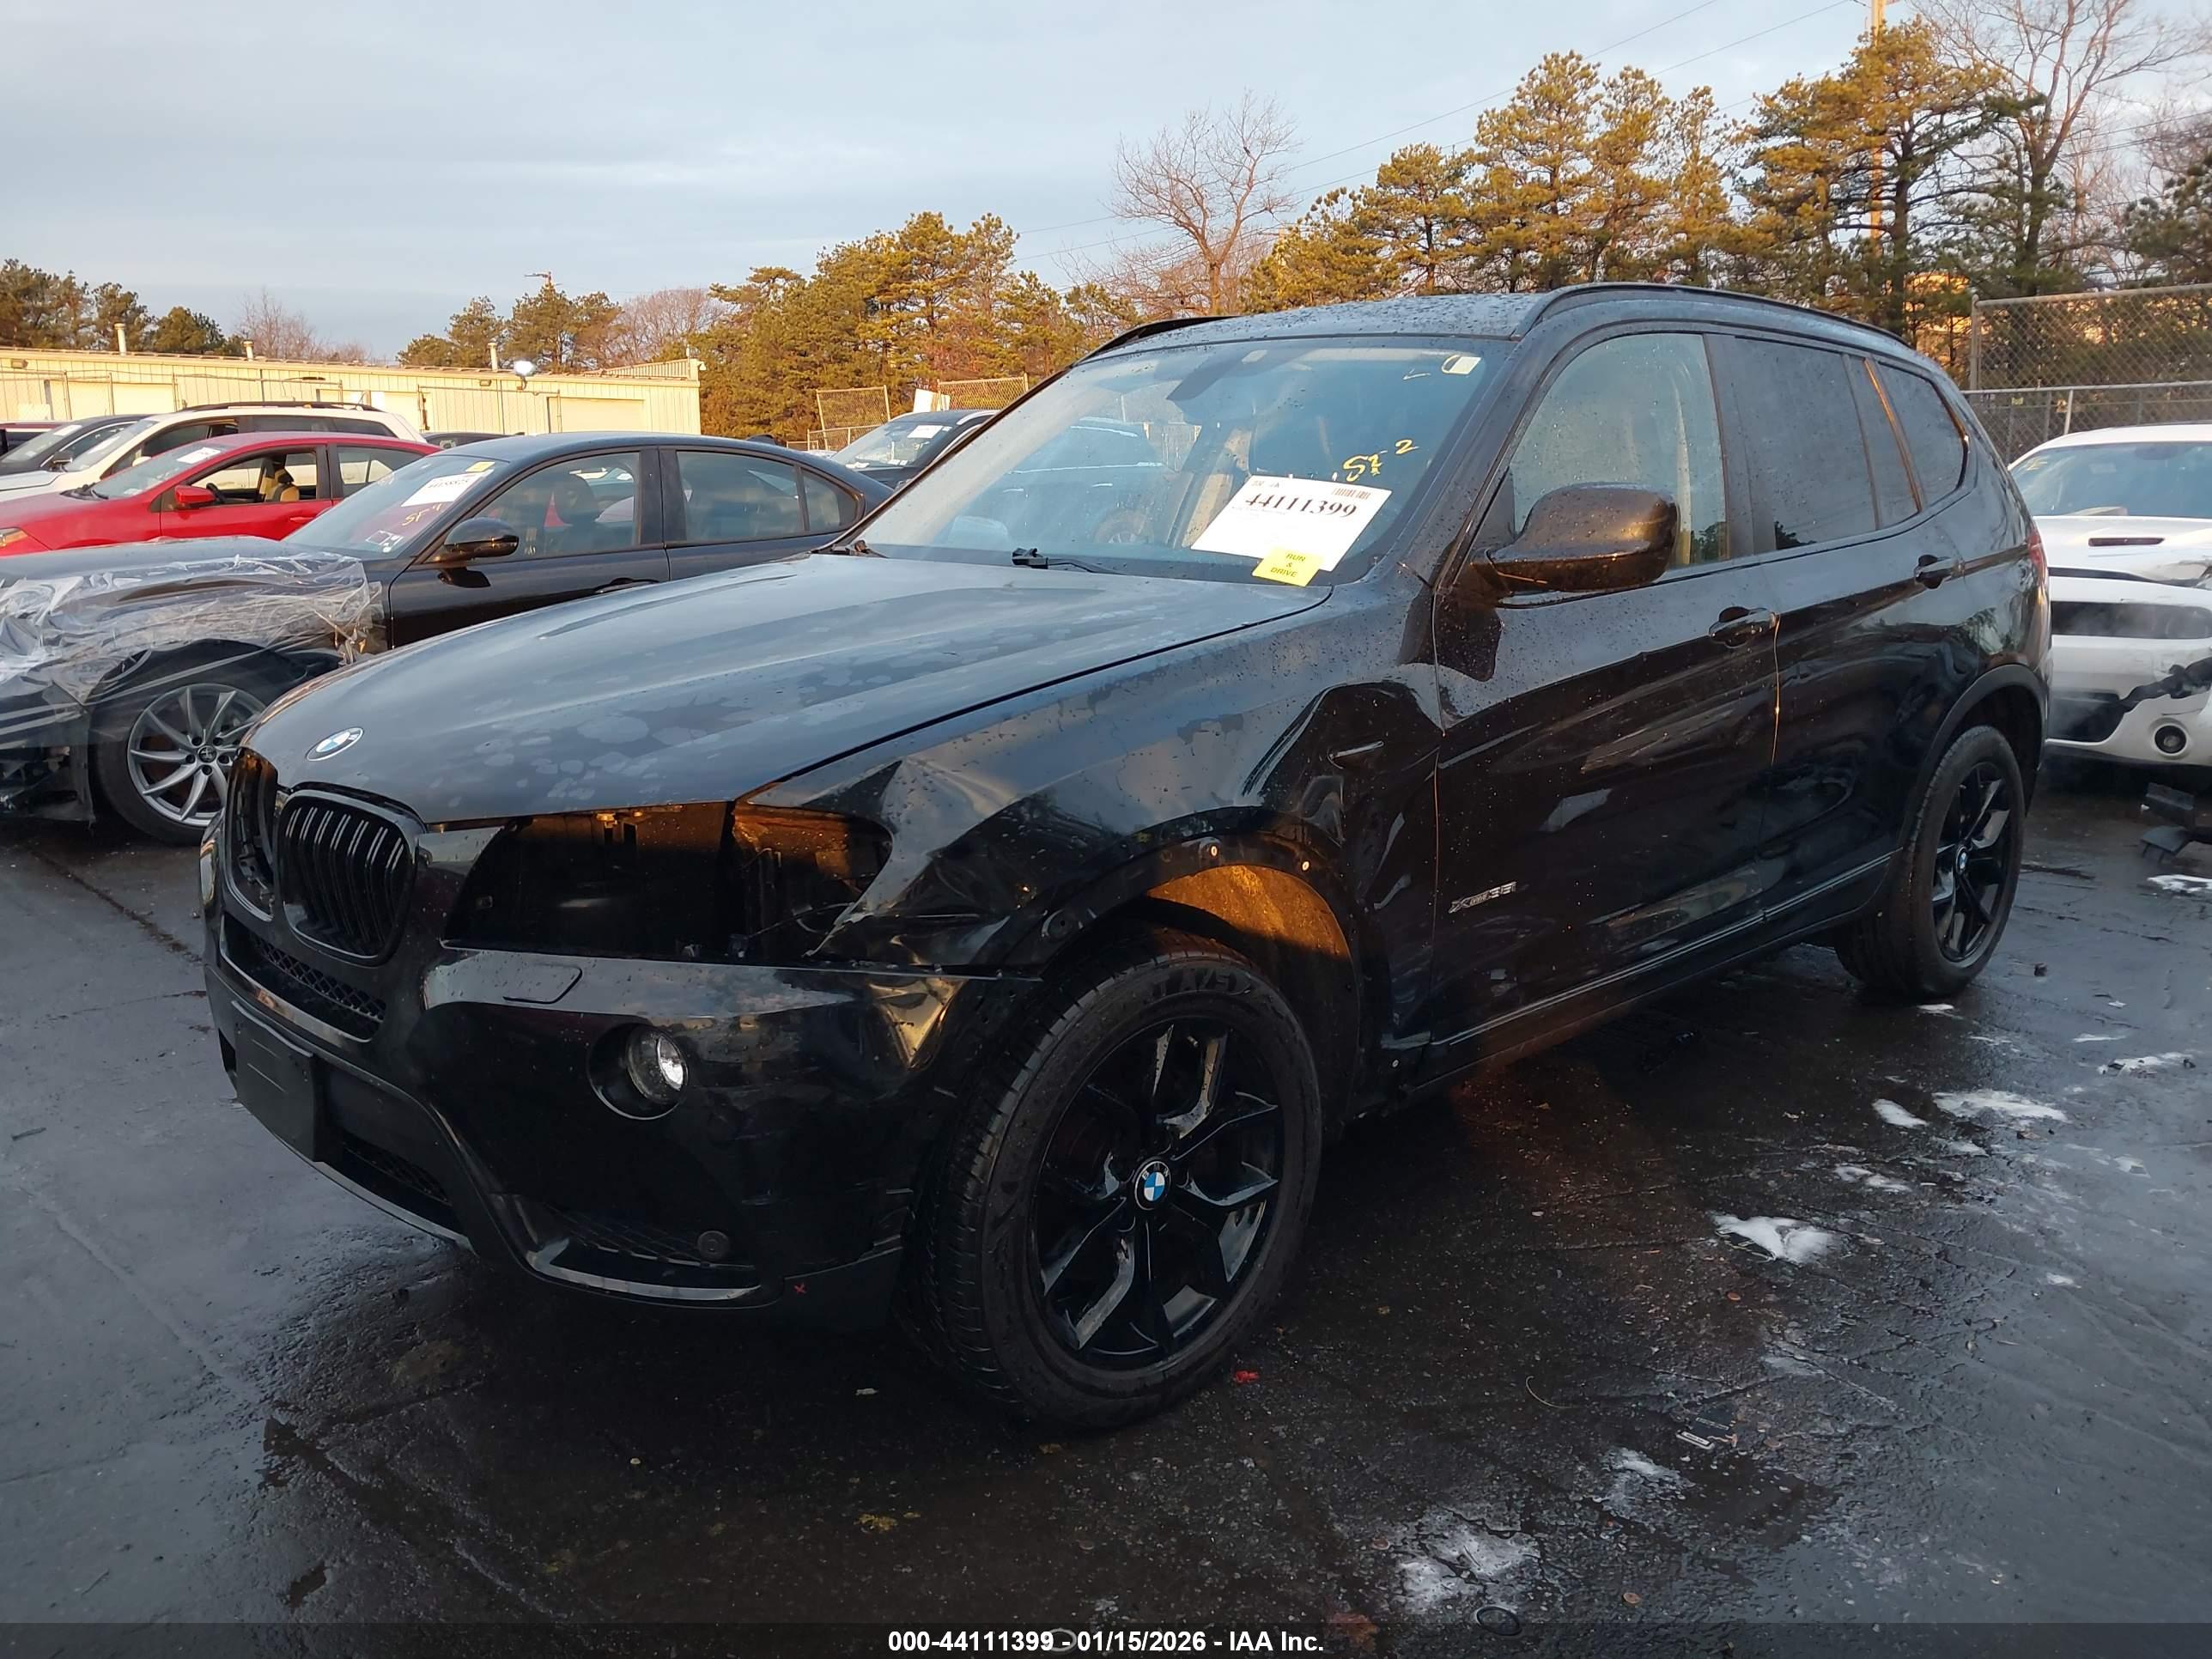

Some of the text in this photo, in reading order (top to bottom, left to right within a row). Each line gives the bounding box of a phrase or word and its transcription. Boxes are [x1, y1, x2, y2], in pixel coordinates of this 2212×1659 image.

[1246, 493, 1358, 517] 44111399
[1285, 553, 1305, 562] RUN
[1271, 567, 1297, 577] DRIVE
